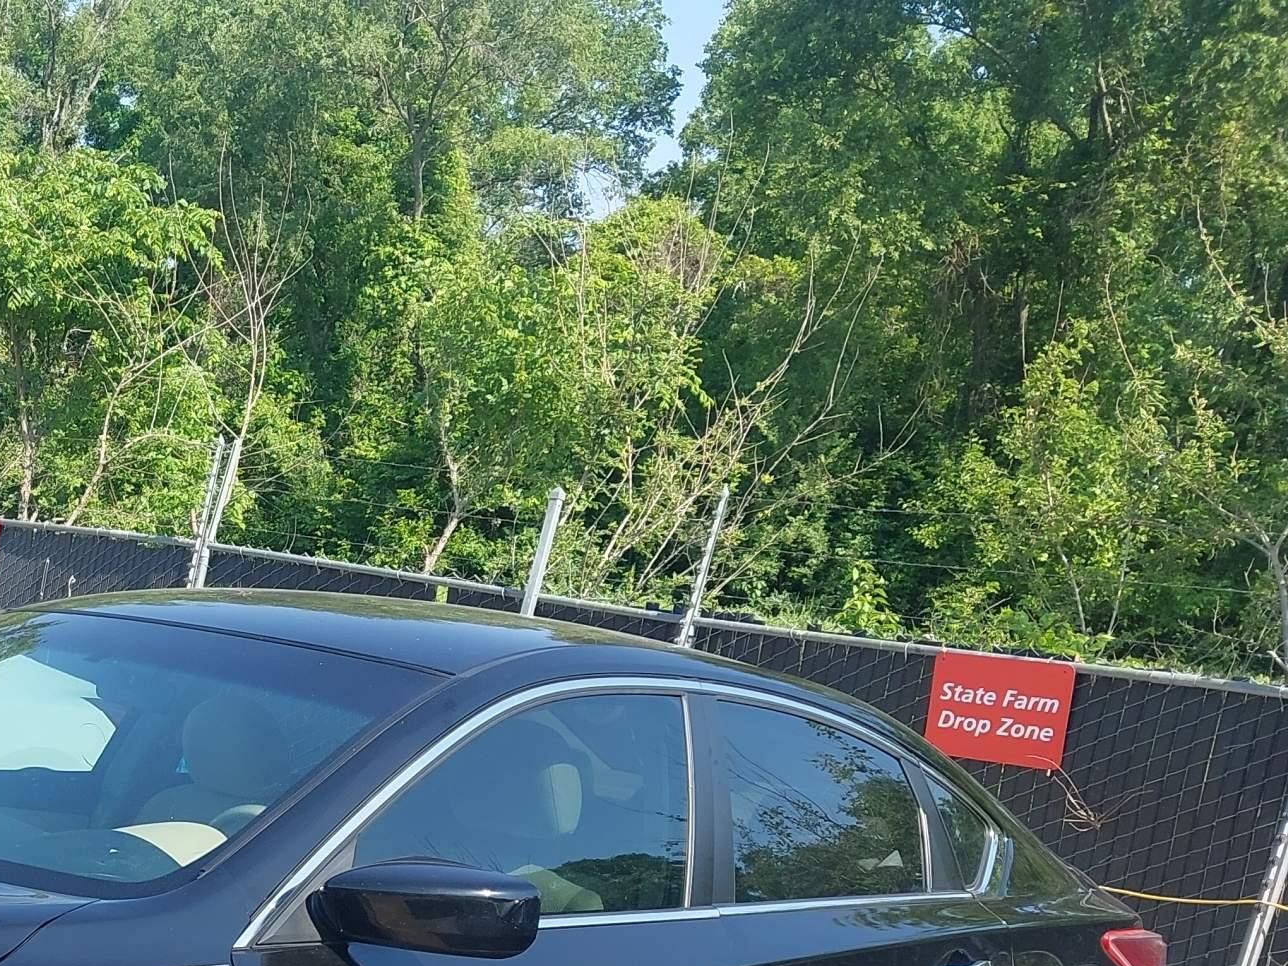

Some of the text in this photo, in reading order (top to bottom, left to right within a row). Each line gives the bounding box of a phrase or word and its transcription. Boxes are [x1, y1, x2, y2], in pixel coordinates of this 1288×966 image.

[939, 682, 1060, 714] State Farm
[937, 710, 1054, 742] Drop Zone
